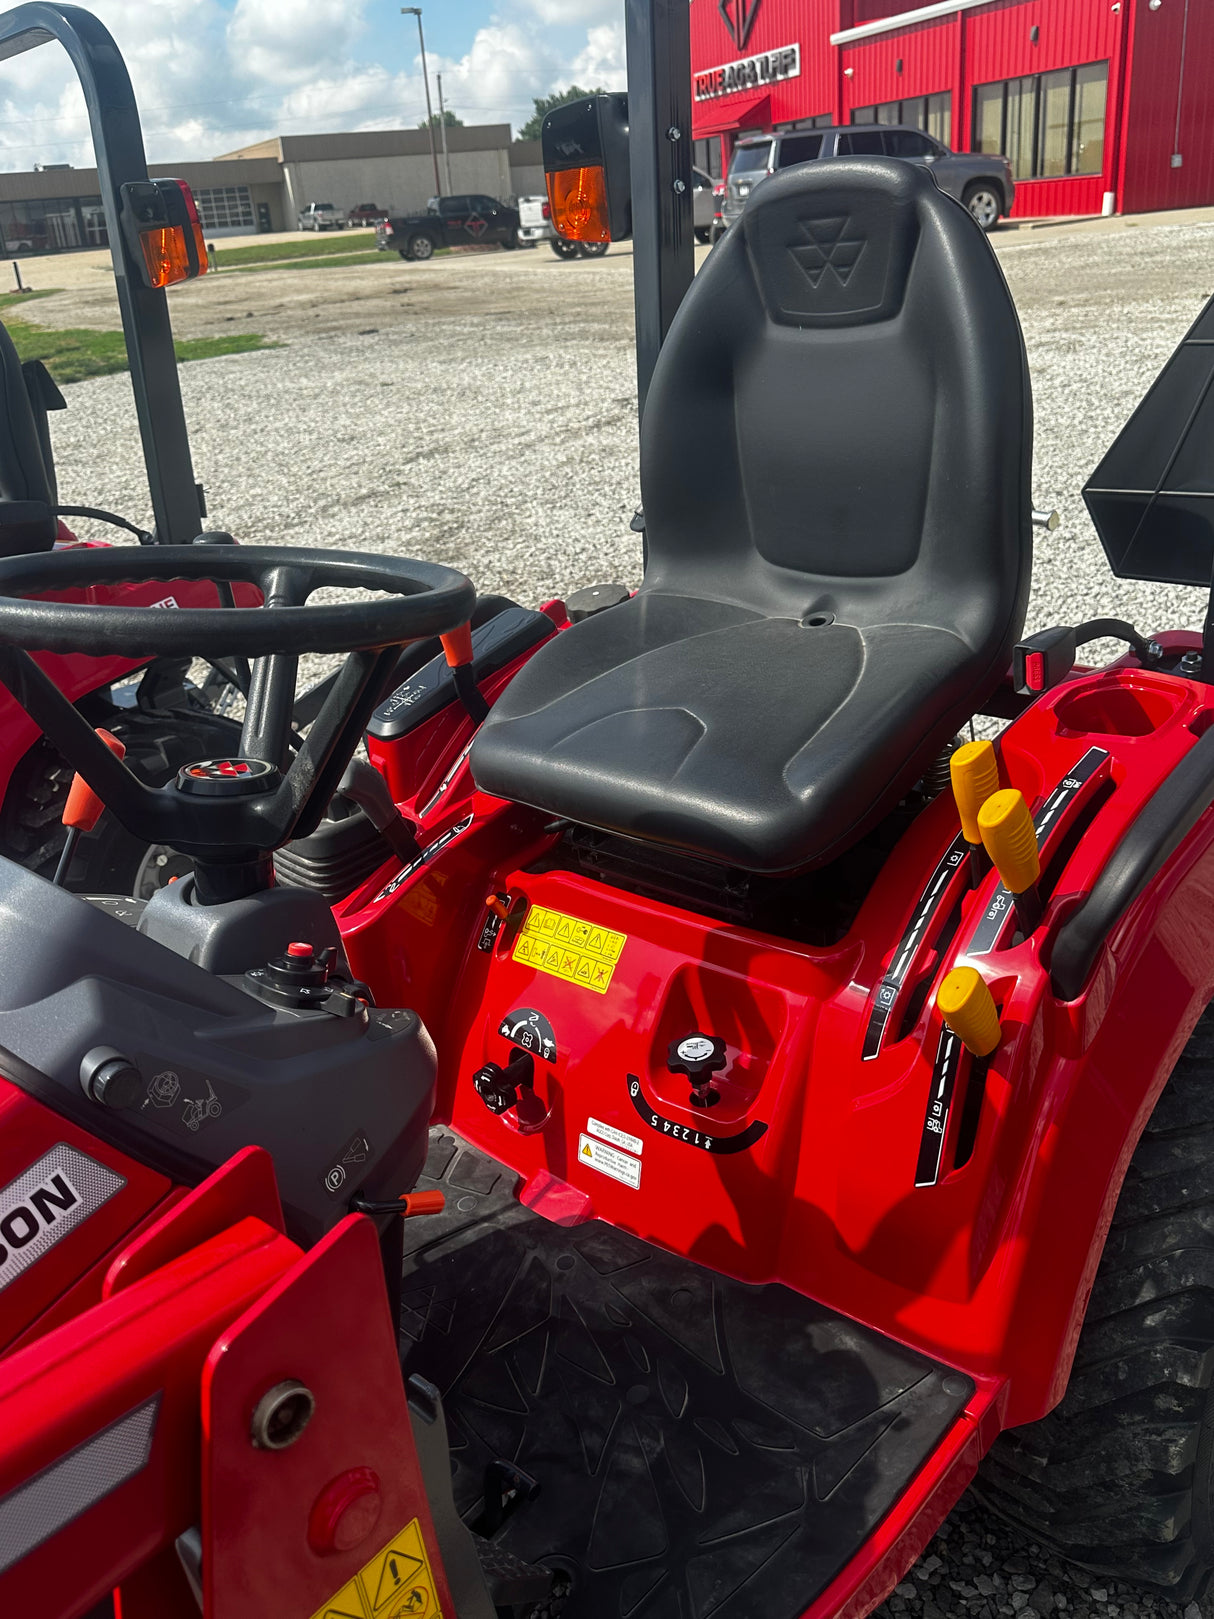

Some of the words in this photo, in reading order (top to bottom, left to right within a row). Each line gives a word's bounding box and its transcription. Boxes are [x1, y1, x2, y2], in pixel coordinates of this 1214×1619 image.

[694, 68, 725, 97] TRUE
[651, 1115, 659, 1126] 5
[663, 1121, 671, 1132] 4
[672, 1125, 681, 1136] 3
[682, 1128, 690, 1140] 2
[695, 1133, 700, 1144] 1
